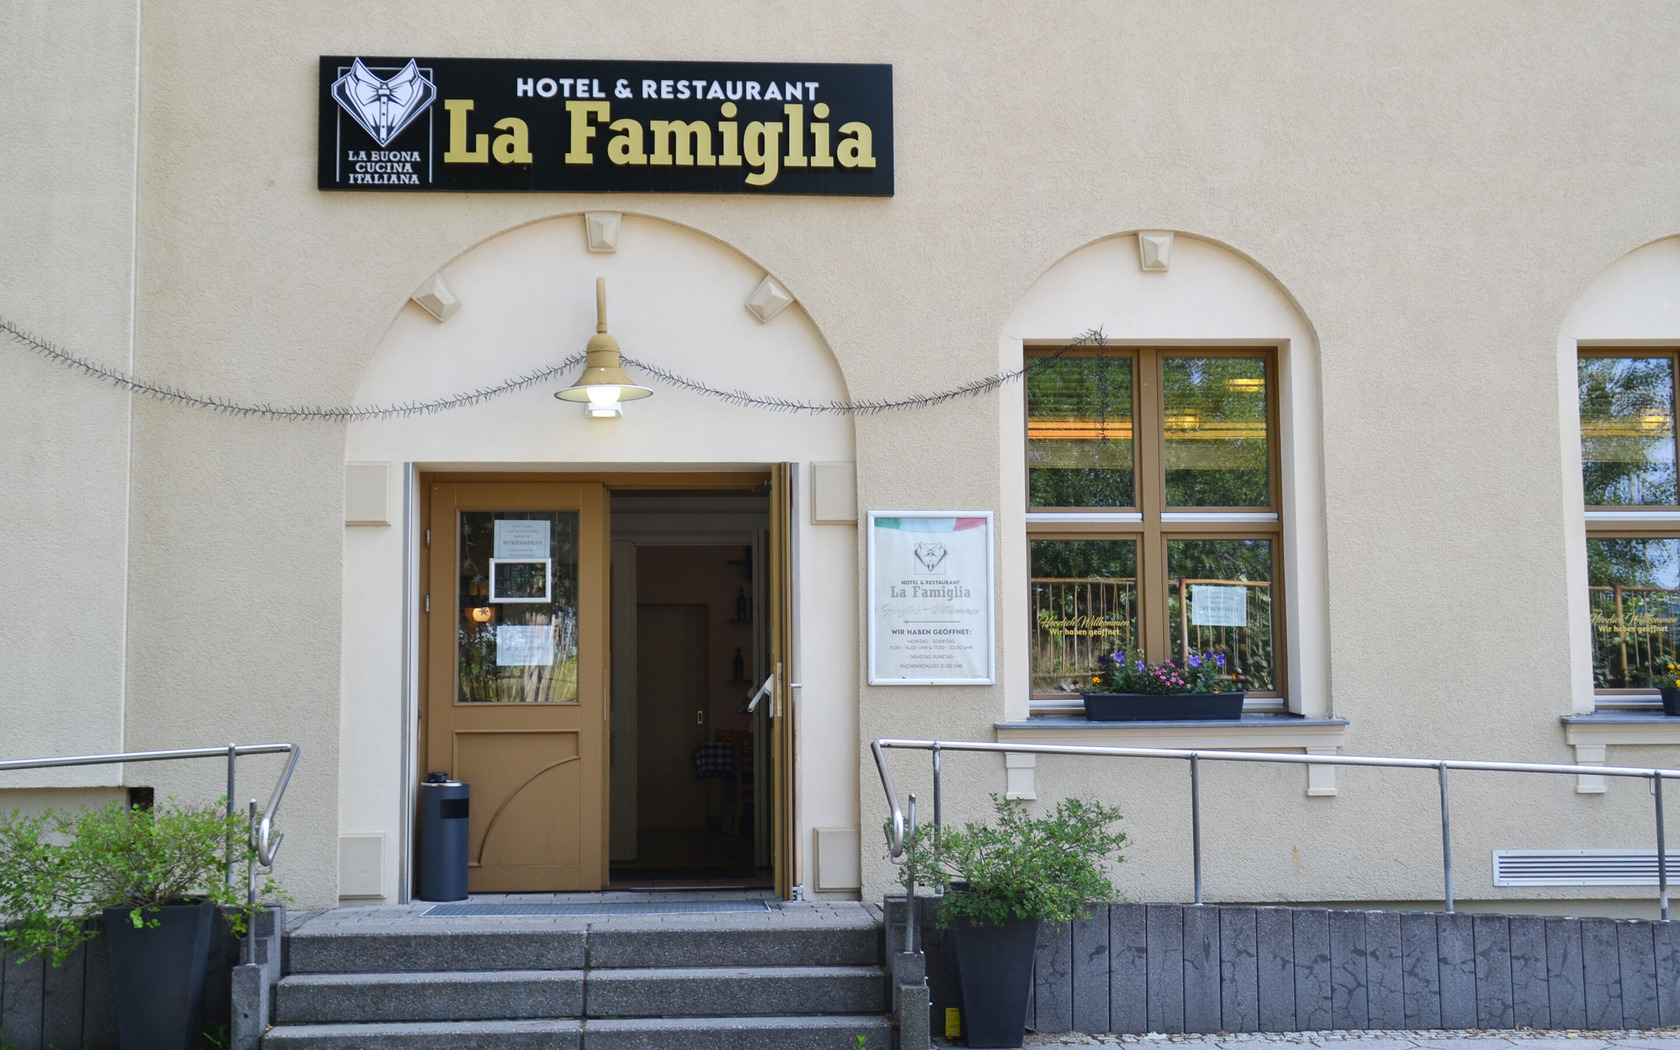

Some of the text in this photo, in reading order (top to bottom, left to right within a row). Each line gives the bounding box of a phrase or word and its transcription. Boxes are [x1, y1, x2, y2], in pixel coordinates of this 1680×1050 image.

[517, 77, 820, 101] HOTEL & RESTAURANT
[444, 99, 876, 186] La Famiglia
[348, 151, 421, 161] LA BUONA
[355, 162, 413, 173] CUCINA
[349, 174, 420, 185] ITALIANA
[890, 586, 971, 601] La Famiglia
[1076, 615, 1130, 628] Willkommen
[1049, 628, 1120, 637] Wir haben geöffnet
[1637, 625, 1669, 633] geöffnet
